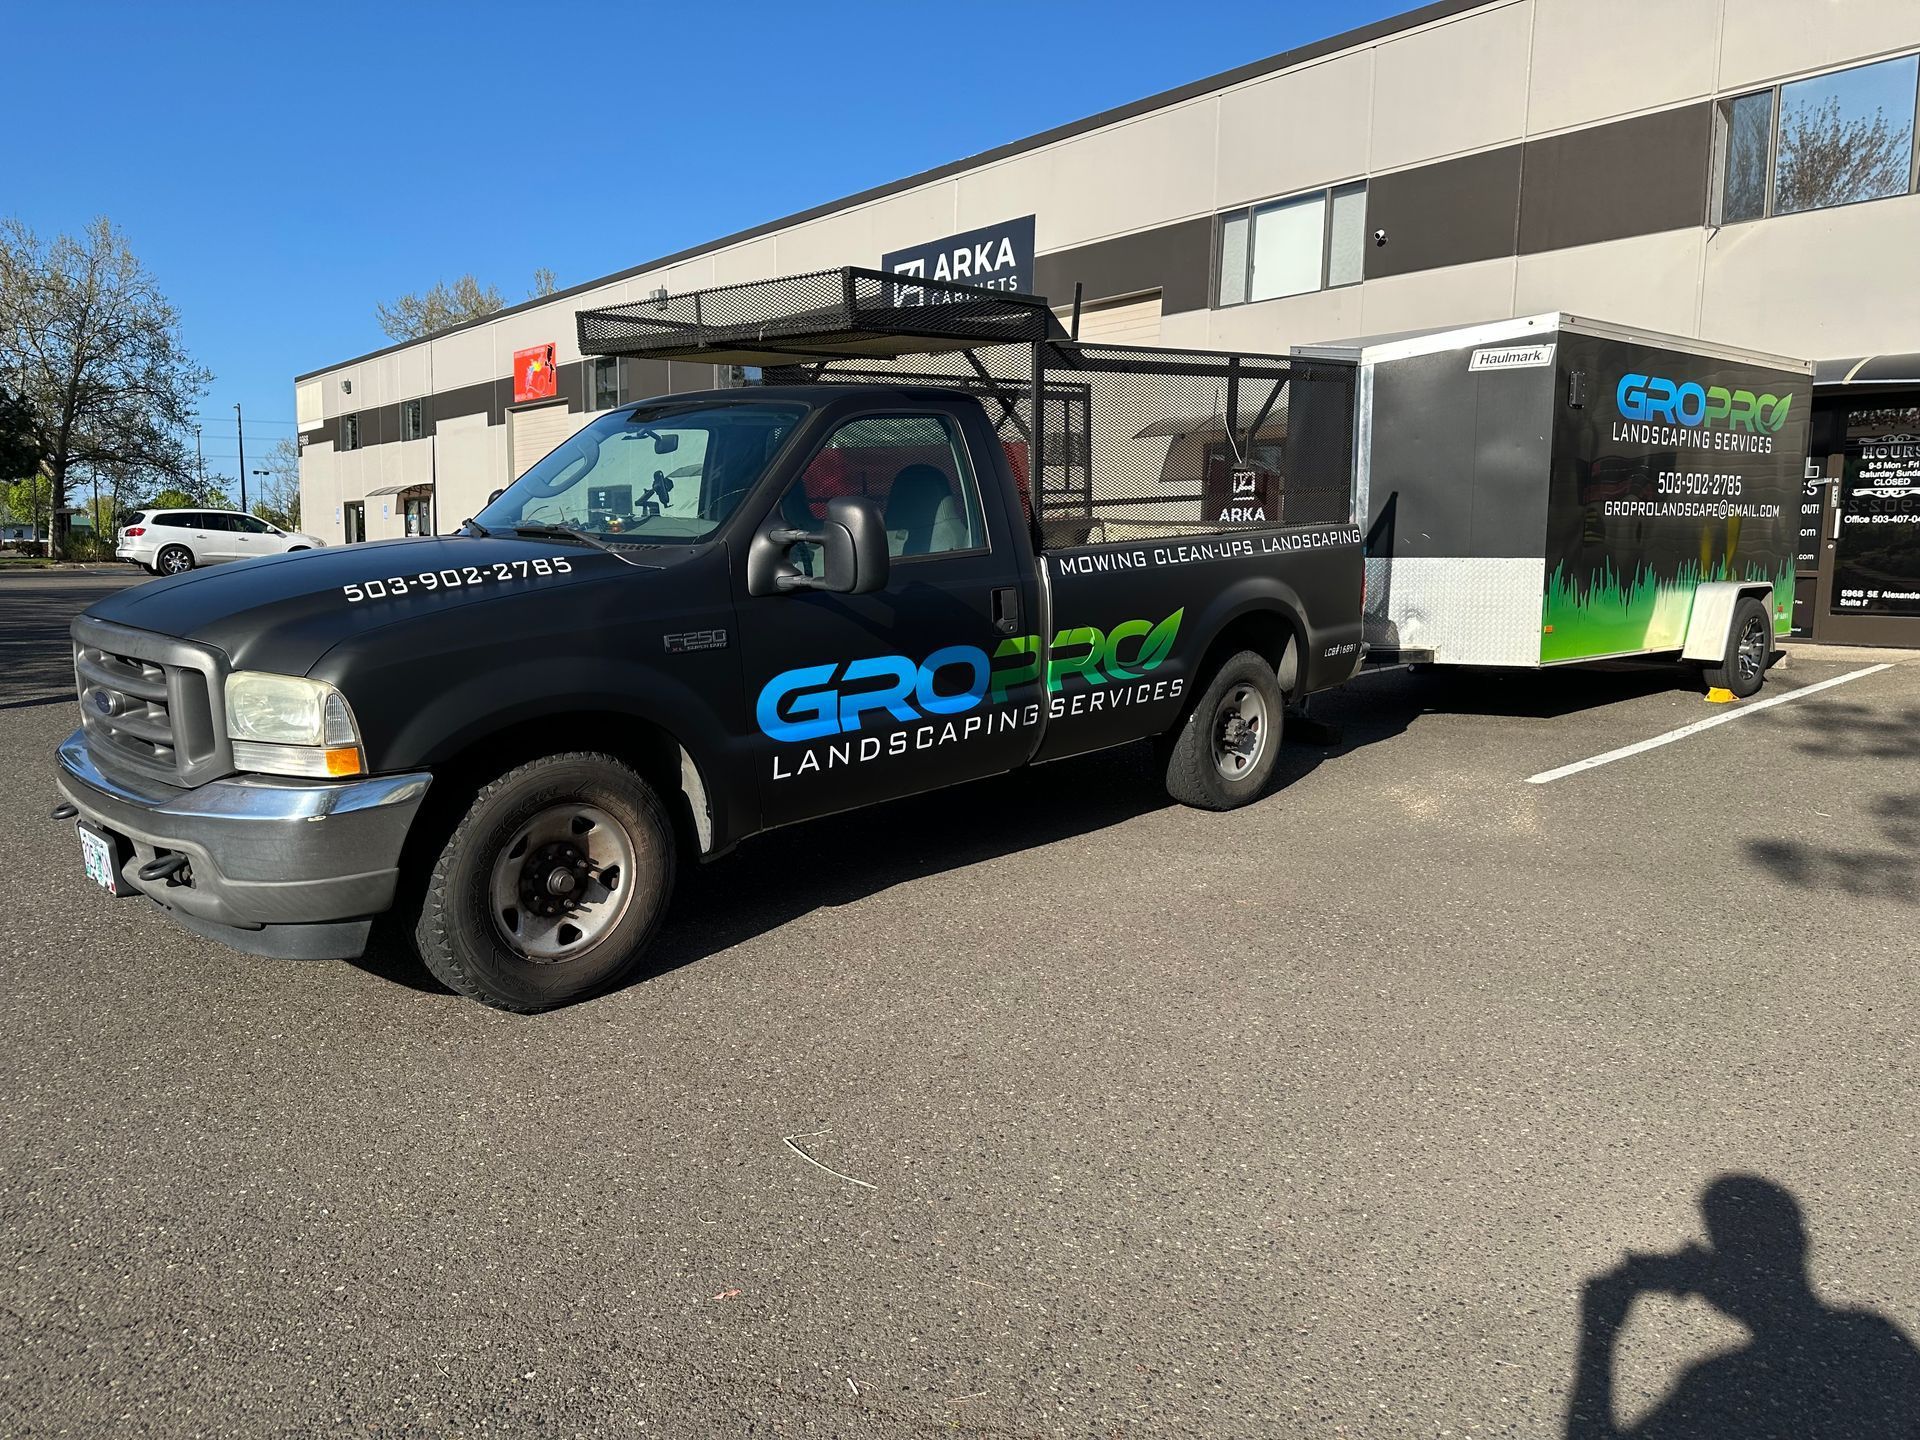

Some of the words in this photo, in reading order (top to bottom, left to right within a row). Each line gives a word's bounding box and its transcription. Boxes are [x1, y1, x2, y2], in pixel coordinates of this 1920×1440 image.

[933, 236, 1016, 281] ARKA
[1480, 350, 1541, 364] Haulmark
[1612, 422, 1710, 449] LANDSCAPING
[1714, 432, 1772, 453] SERVICES
[1868, 462, 1882, 470] 9-5
[1884, 461, 1901, 469] Mon
[1859, 470, 1895, 479] Saturday
[1873, 478, 1911, 486] CLOSED
[1219, 507, 1266, 522] ARKA
[1604, 499, 1780, 520] GROPROLANDSCAPE@GMAIL.COM
[1844, 515, 1870, 523] Office
[1059, 551, 1146, 575] MOWING
[1154, 541, 1253, 565] CLEAN-UPS
[1261, 529, 1361, 553] LANDSCAPING
[343, 557, 573, 602] 503-902-2785
[1867, 590, 1878, 598] SE
[1840, 598, 1861, 607] Suite
[1862, 599, 1868, 607] F
[772, 704, 1039, 781] LANDSCAPING
[1049, 678, 1184, 719] SERVICES
